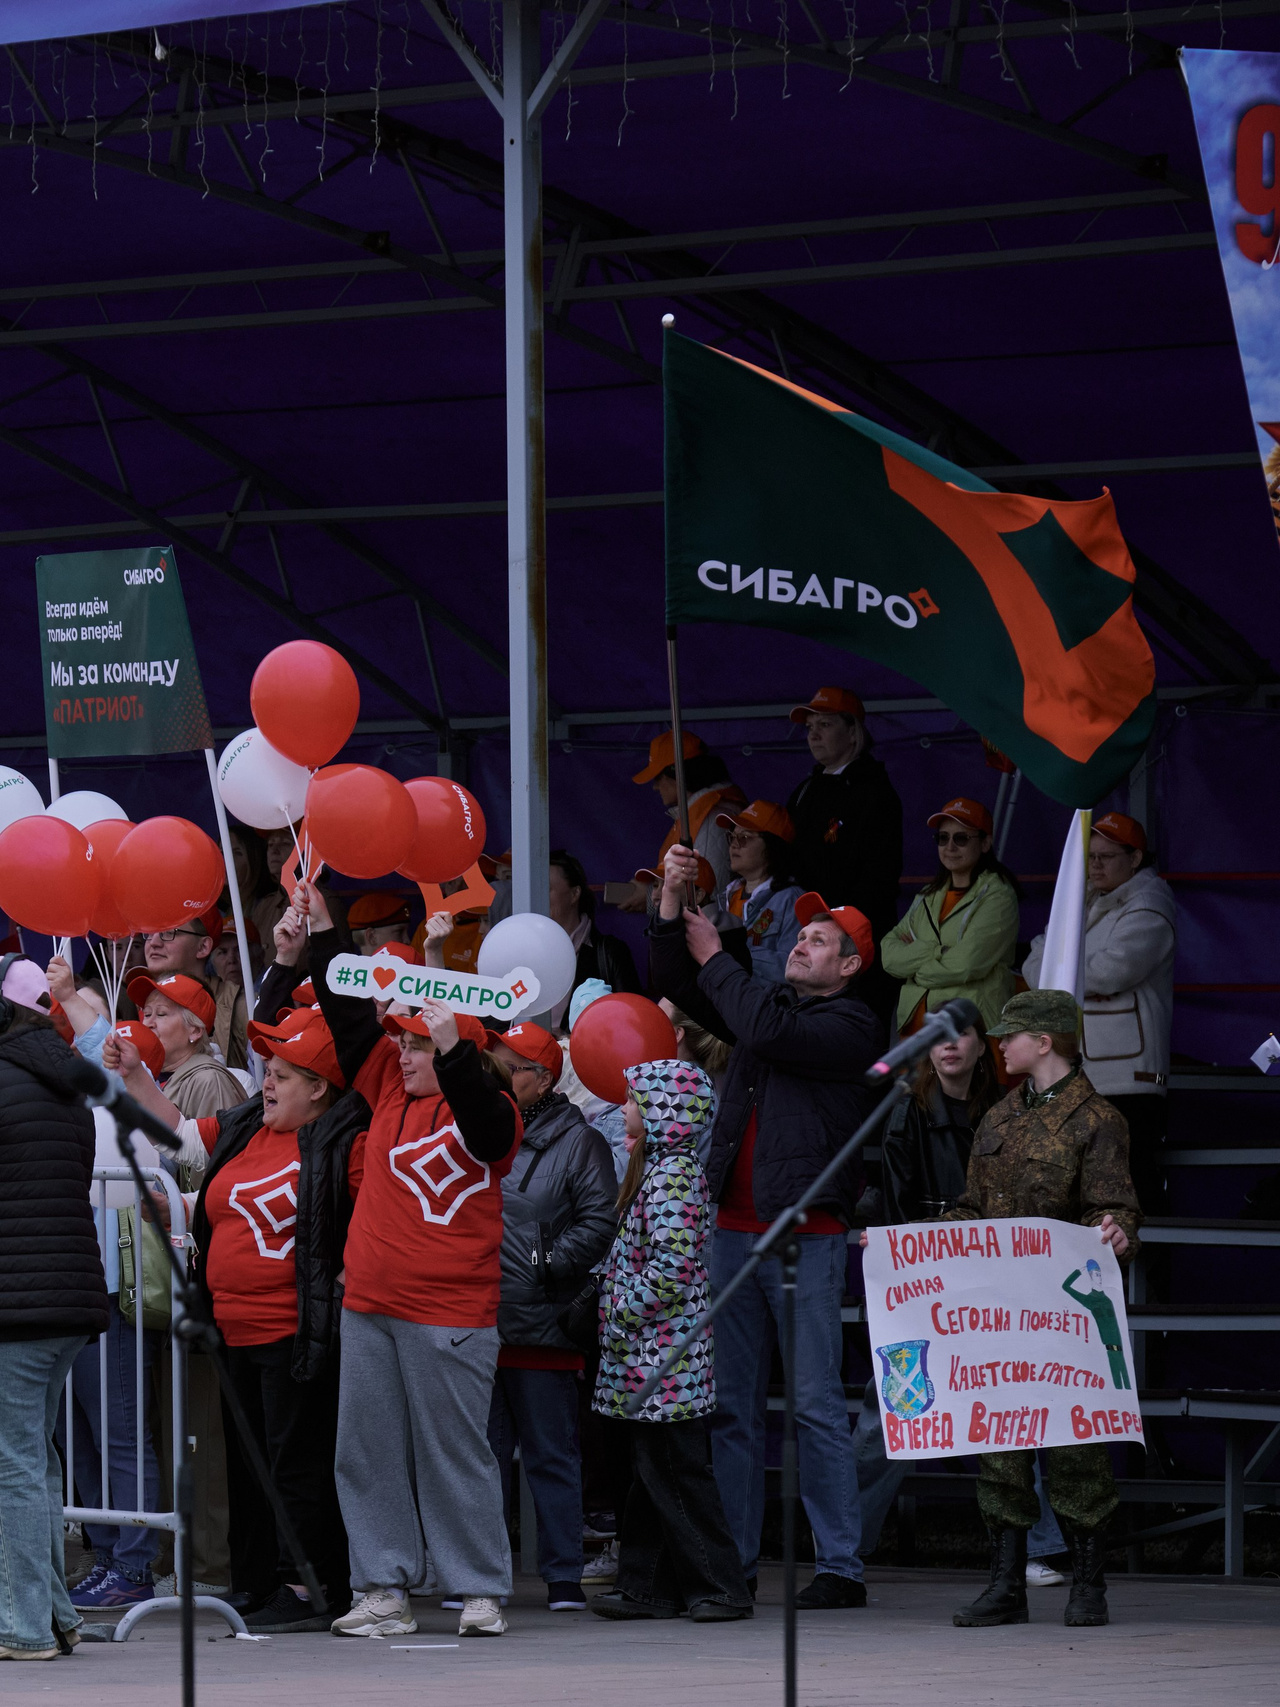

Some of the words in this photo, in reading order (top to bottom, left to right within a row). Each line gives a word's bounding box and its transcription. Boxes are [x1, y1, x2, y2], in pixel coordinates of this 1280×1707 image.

[123, 566, 165, 586] СИБАГРО
[697, 559, 918, 629] СИБАГРО
[46, 600, 77, 619] Всегда
[79, 597, 109, 618] идём
[47, 627, 78, 643] только
[80, 621, 123, 643] вперёд!
[51, 661, 74, 687] Мы
[78, 664, 98, 686] за
[103, 659, 180, 687] команду
[53, 695, 145, 725] «ПАТРИОТ»
[221, 742, 250, 781] СИБАГРО
[452, 785, 472, 833] СИБАГРО
[336, 966, 368, 988] #Я
[398, 975, 512, 1010] СИБАГРО
[886, 1225, 1002, 1271] КОМАНДА
[1011, 1225, 1052, 1259] НАША
[885, 1275, 945, 1312] СИЛНАЯ
[930, 1302, 1011, 1336] СЕГОДНЯ
[1019, 1309, 1090, 1344] ПОВЕЗЁТ!
[967, 1401, 1050, 1447] ВПЕРЁД!
